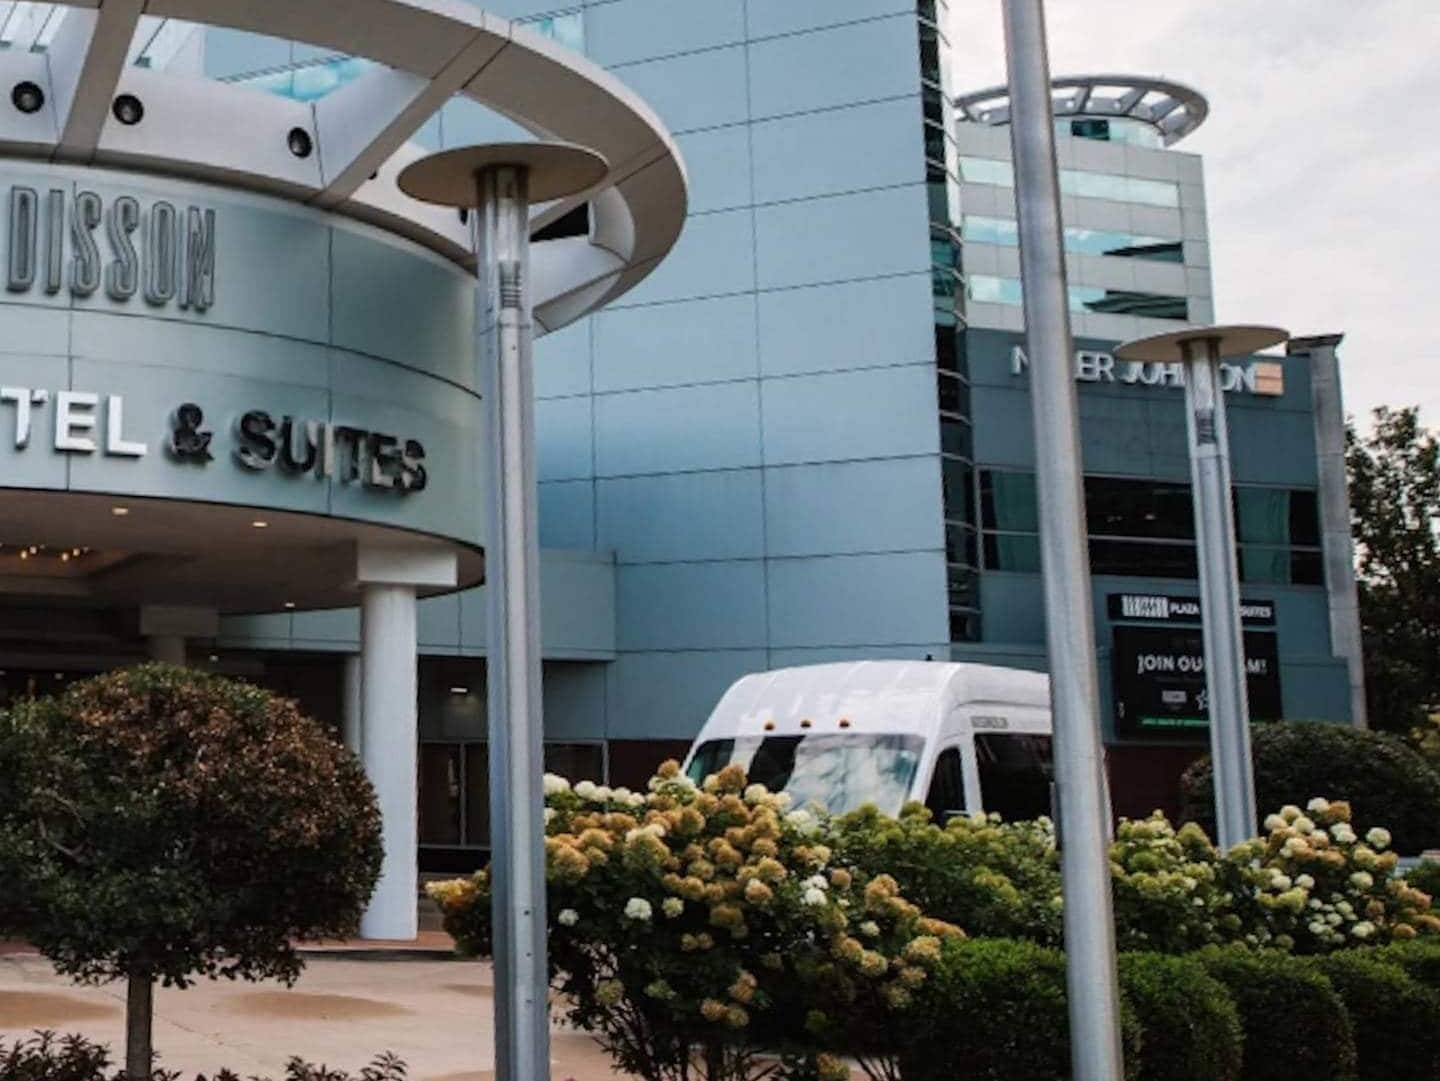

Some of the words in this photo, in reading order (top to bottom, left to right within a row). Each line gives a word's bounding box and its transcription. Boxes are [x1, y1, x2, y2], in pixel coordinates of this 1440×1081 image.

[169, 402, 214, 465] &
[236, 409, 428, 493] SUITES
[1136, 653, 1175, 675] JOIN
[1177, 654, 1204, 672] OU
